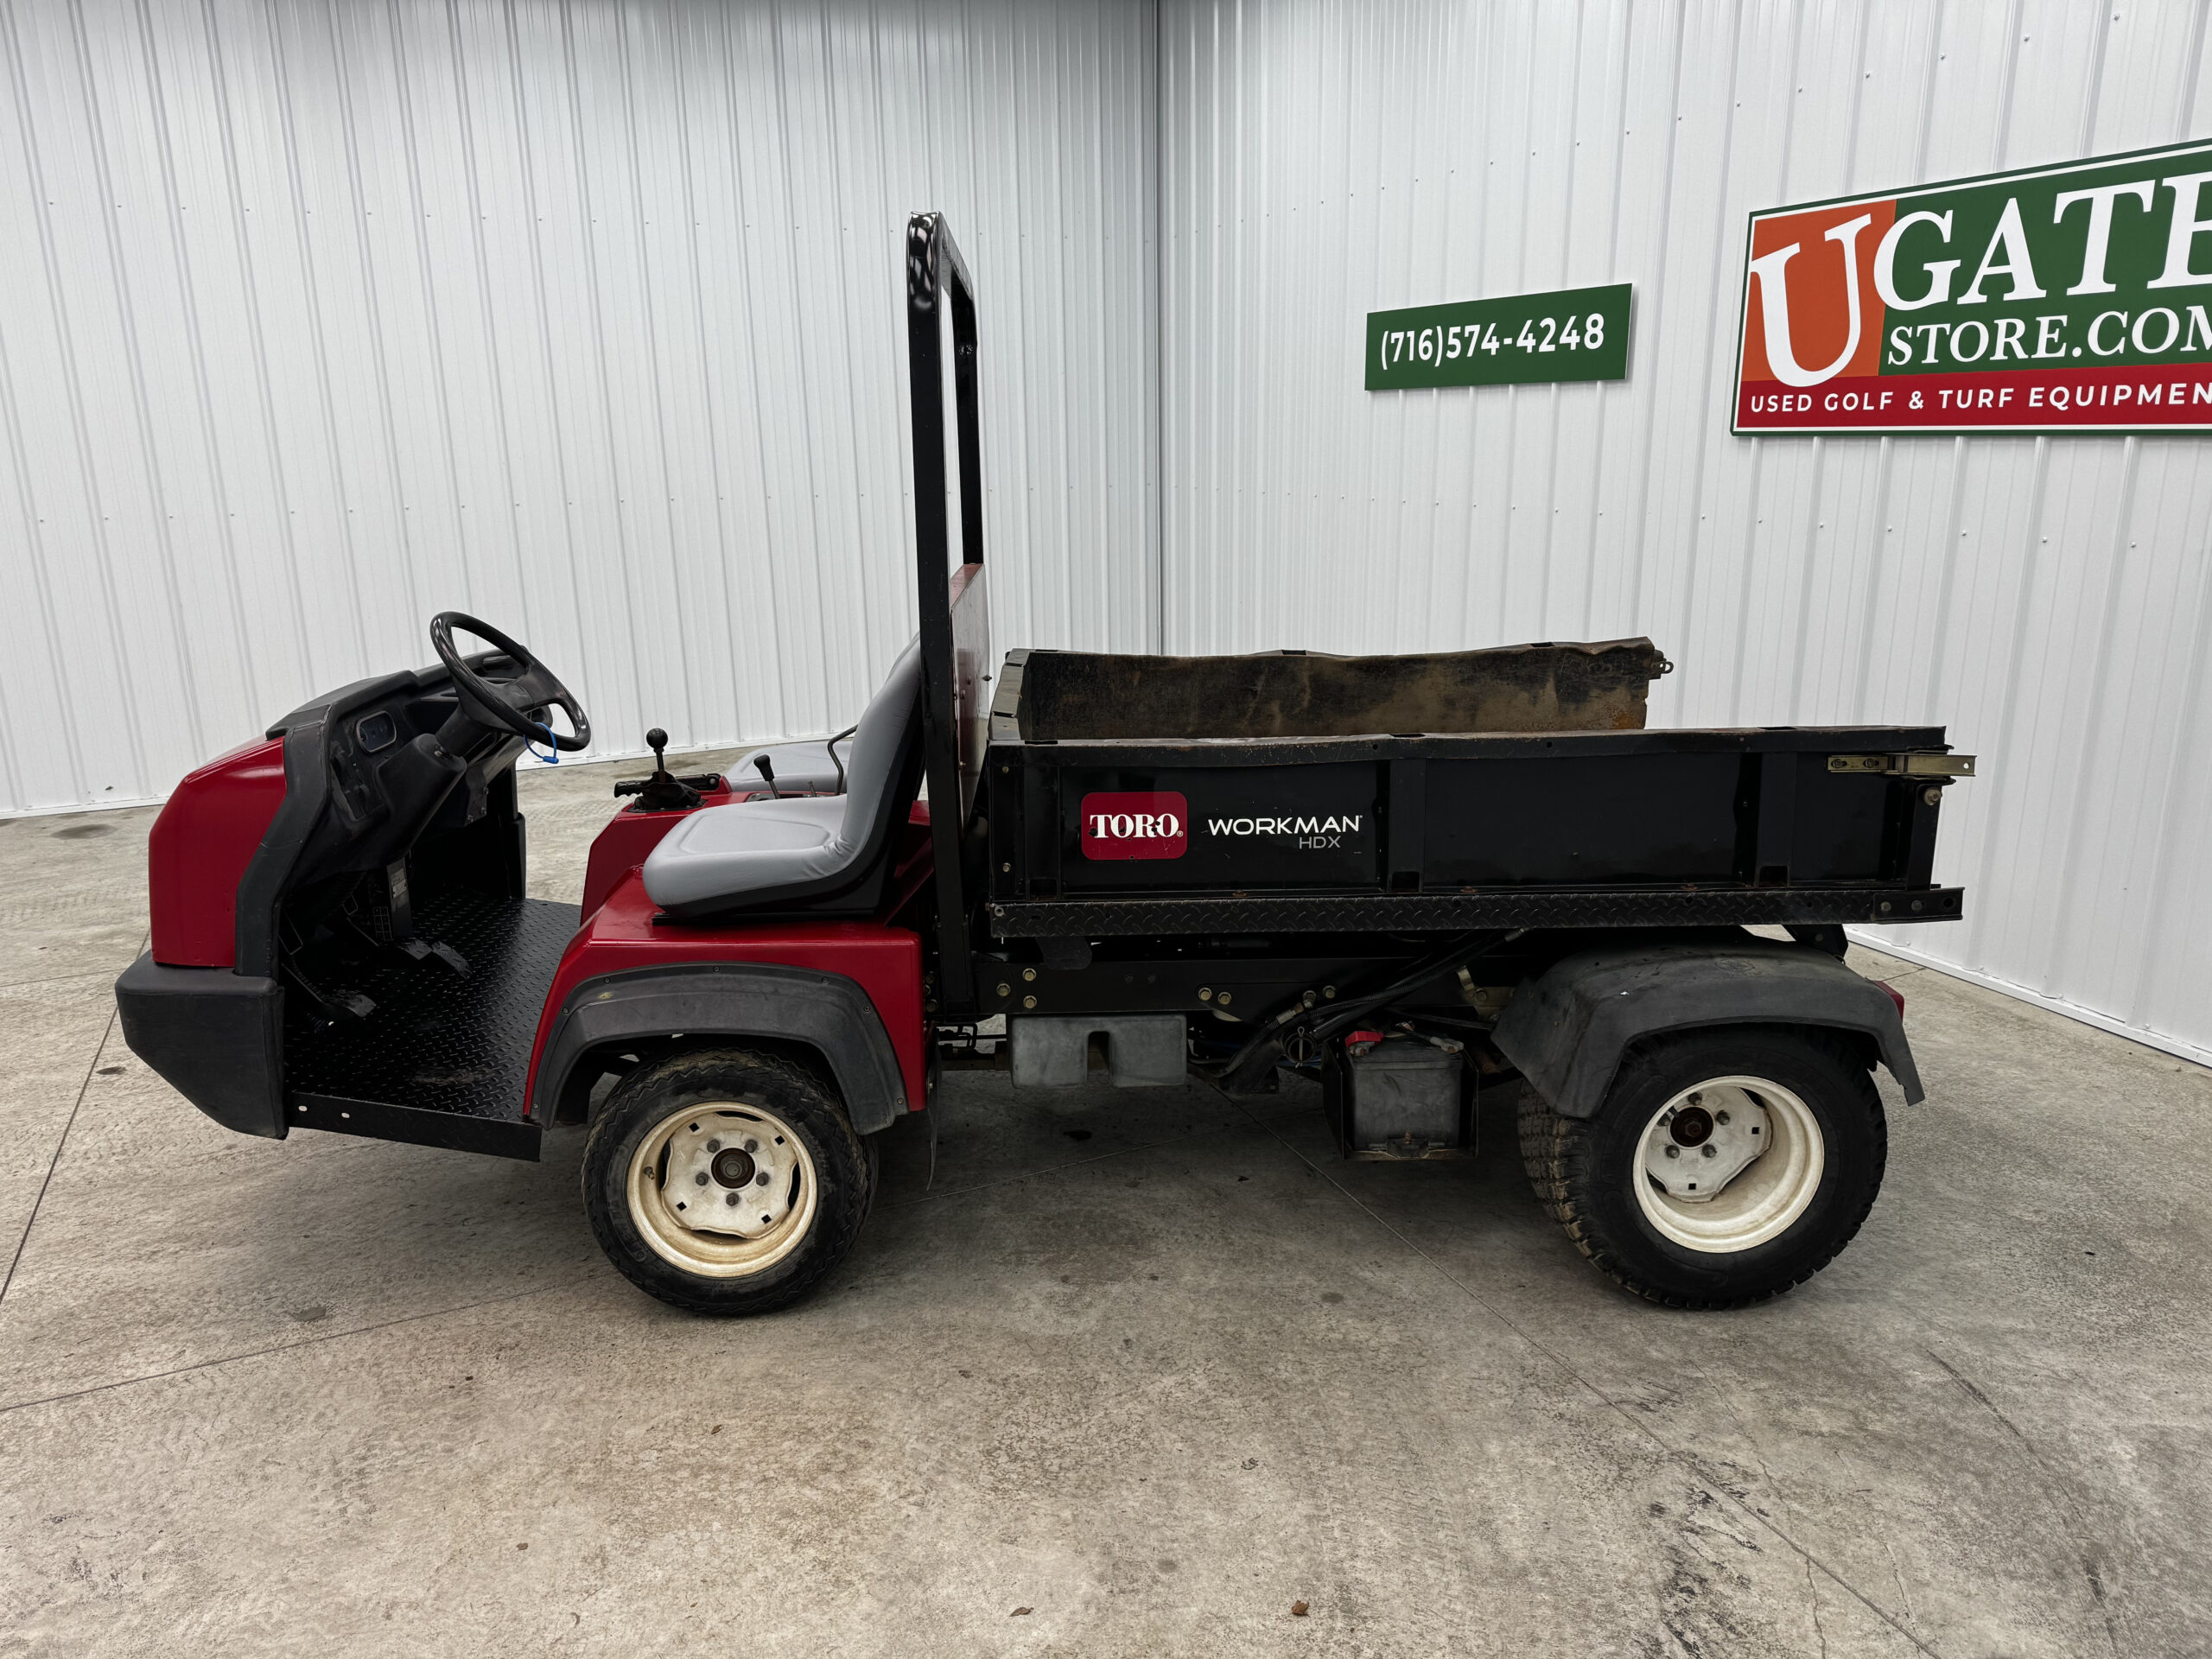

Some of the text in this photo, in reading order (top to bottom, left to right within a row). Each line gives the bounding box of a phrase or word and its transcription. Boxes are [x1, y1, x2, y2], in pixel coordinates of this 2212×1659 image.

[1381, 313, 1605, 371] (716)574-4248
[1751, 394, 1813, 413] USED
[1823, 391, 1894, 411] GOLF
[1908, 390, 1924, 410] &
[1938, 388, 2015, 410] TURF
[1090, 813, 1179, 839] TORO
[1208, 815, 1362, 836] WORKMAN
[1299, 836, 1341, 849] HDX
